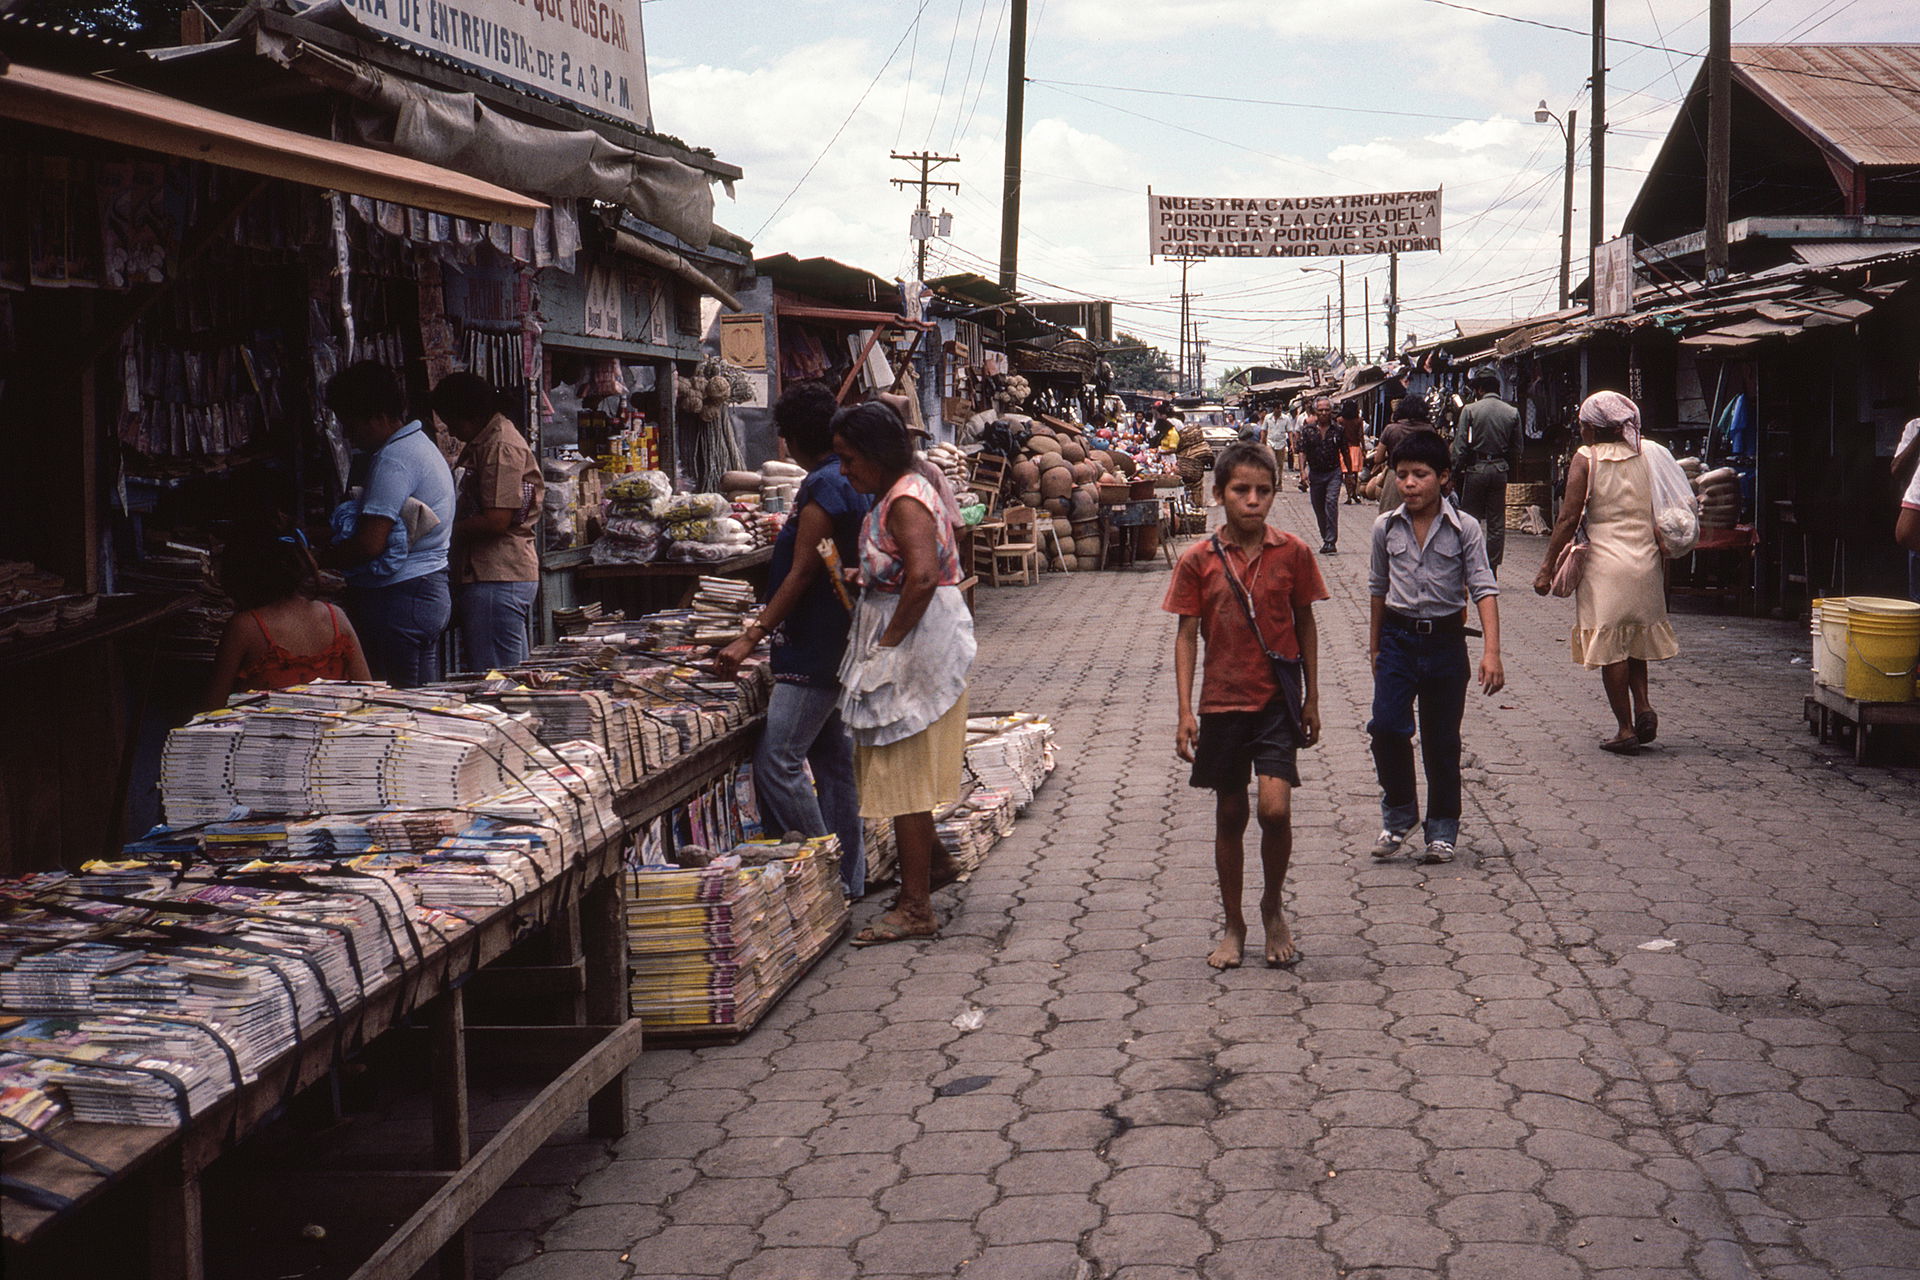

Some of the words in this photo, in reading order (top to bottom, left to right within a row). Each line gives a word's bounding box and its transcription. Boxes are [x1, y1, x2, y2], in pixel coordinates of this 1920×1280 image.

[570, 0, 629, 52] BUSCAR
[399, 0, 420, 33] DE
[430, 0, 534, 73] ENTREVISTA:
[537, 50, 554, 81] DE
[561, 51, 572, 87] 2
[578, 66, 586, 93] A
[591, 64, 598, 98] 3
[1159, 197, 1258, 211] NUESTRA
[1265, 197, 1336, 211] CAUSA
[1161, 212, 1239, 228] PORQUE
[1246, 214, 1273, 228] ES
[1280, 213, 1305, 227] LA
[1314, 210, 1380, 226] CAUSA
[1274, 225, 1357, 242] PORQUE
[1362, 224, 1389, 239] ES
[1394, 222, 1419, 236] LA
[1161, 244, 1221, 257] CAUSA
[1225, 244, 1263, 257] DEL
